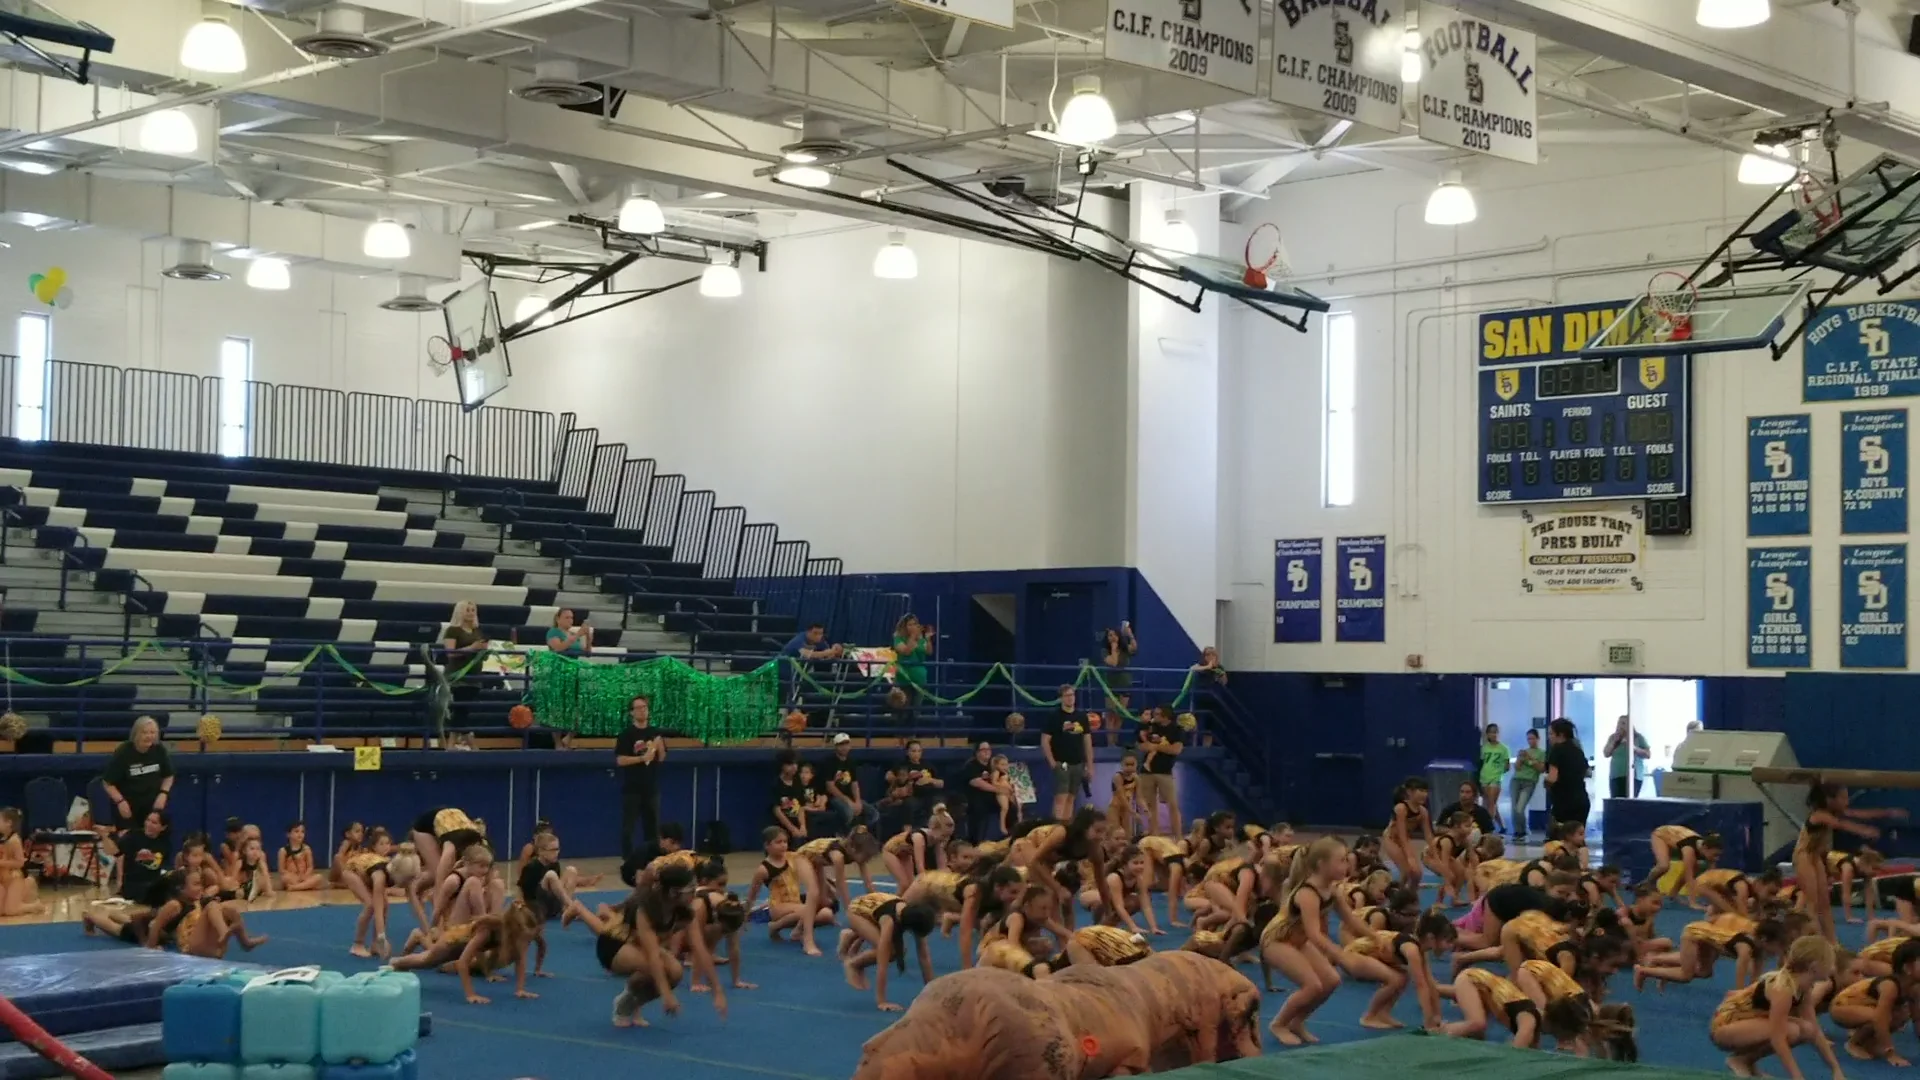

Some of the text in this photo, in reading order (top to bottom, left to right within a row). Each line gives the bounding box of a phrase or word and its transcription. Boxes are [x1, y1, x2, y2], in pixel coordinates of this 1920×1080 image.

[1113, 9, 1254, 65] C.I.F. CHAMPIONS
[1168, 48, 1208, 76] 2009
[1423, 20, 1533, 96] FOOTBALL
[1277, 54, 1398, 105] C.I.F. CHAMPIONS
[1323, 88, 1357, 115] 2009
[1423, 95, 1532, 138] C.I.F. CHAMPIONS
[1462, 127, 1490, 150] 2013
[1484, 306, 1656, 359] SAN DIM
[1807, 314, 1842, 346] BOYS
[1871, 357, 1918, 370] STATE
[1807, 368, 1920, 387] REGIONAL FINAL
[1627, 393, 1668, 409] GUEST
[1490, 403, 1531, 419] SAINTS
[1563, 406, 1592, 418] PERIOD
[1550, 449, 1580, 460] PLAYER
[1646, 444, 1674, 454] FOULS
[1487, 453, 1512, 463] FOULS
[1563, 487, 1592, 497] MATCH
[1647, 483, 1675, 494] SCORE
[1843, 488, 1905, 500] X-COUNTRY
[1486, 490, 1511, 501] SCORE
[1531, 515, 1632, 537] THE HOUSE THAT
[1541, 534, 1623, 549] PRES BUILT
[1276, 599, 1320, 609] CHAMPIONS
[1338, 598, 1383, 608] CHAMPIONS
[1763, 613, 1797, 623] GIRLS
[1758, 624, 1802, 634] TENNIS
[1842, 623, 1904, 635] X-COUNTRY
[1484, 752, 1501, 764] 72
